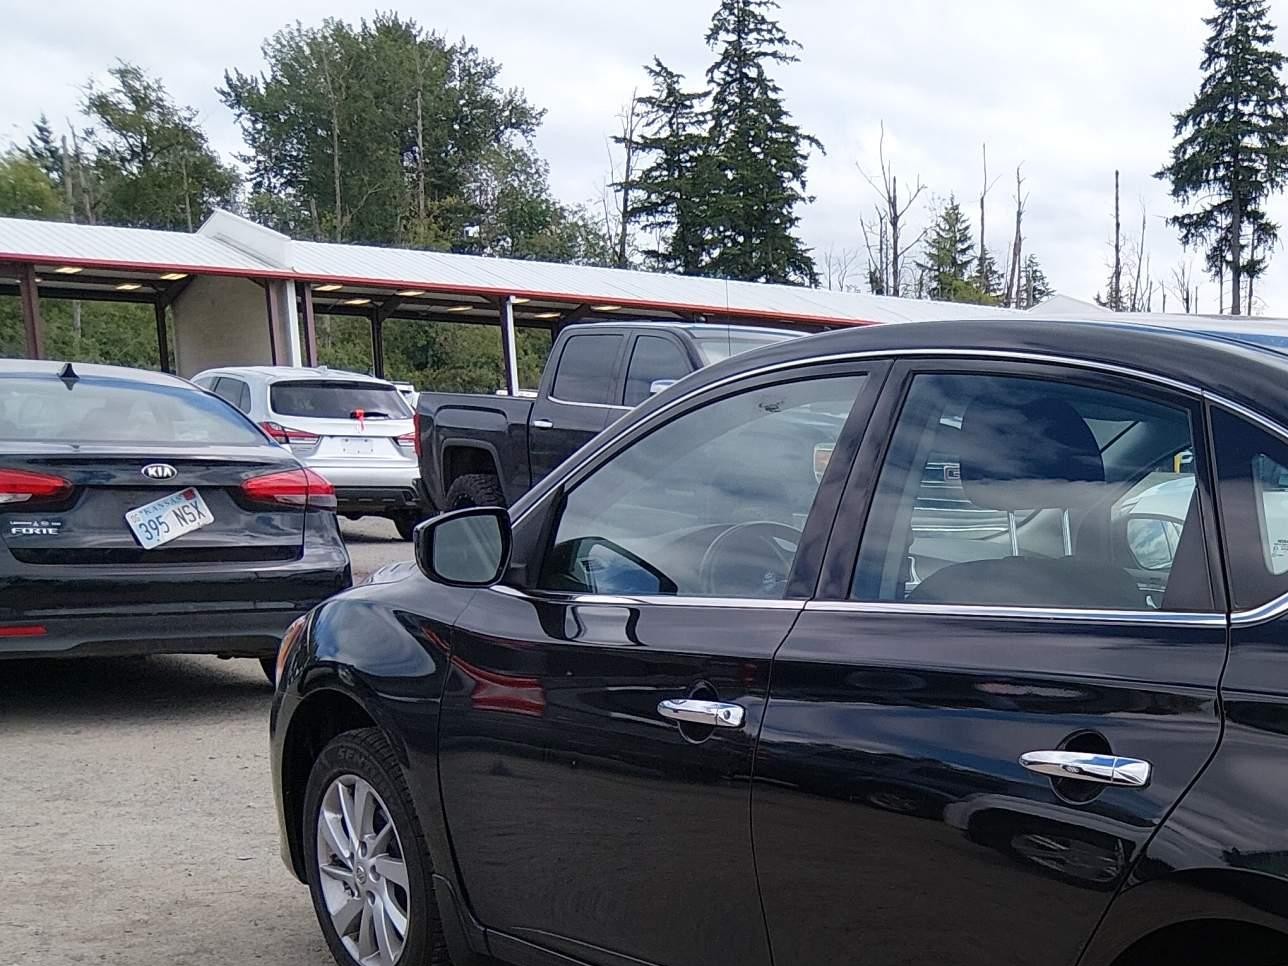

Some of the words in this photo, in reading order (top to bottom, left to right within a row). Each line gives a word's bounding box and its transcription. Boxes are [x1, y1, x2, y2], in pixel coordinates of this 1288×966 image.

[147, 466, 172, 477] KIA
[138, 515, 170, 541] 395
[172, 500, 206, 527] NSX
[10, 526, 59, 535] FORTE
